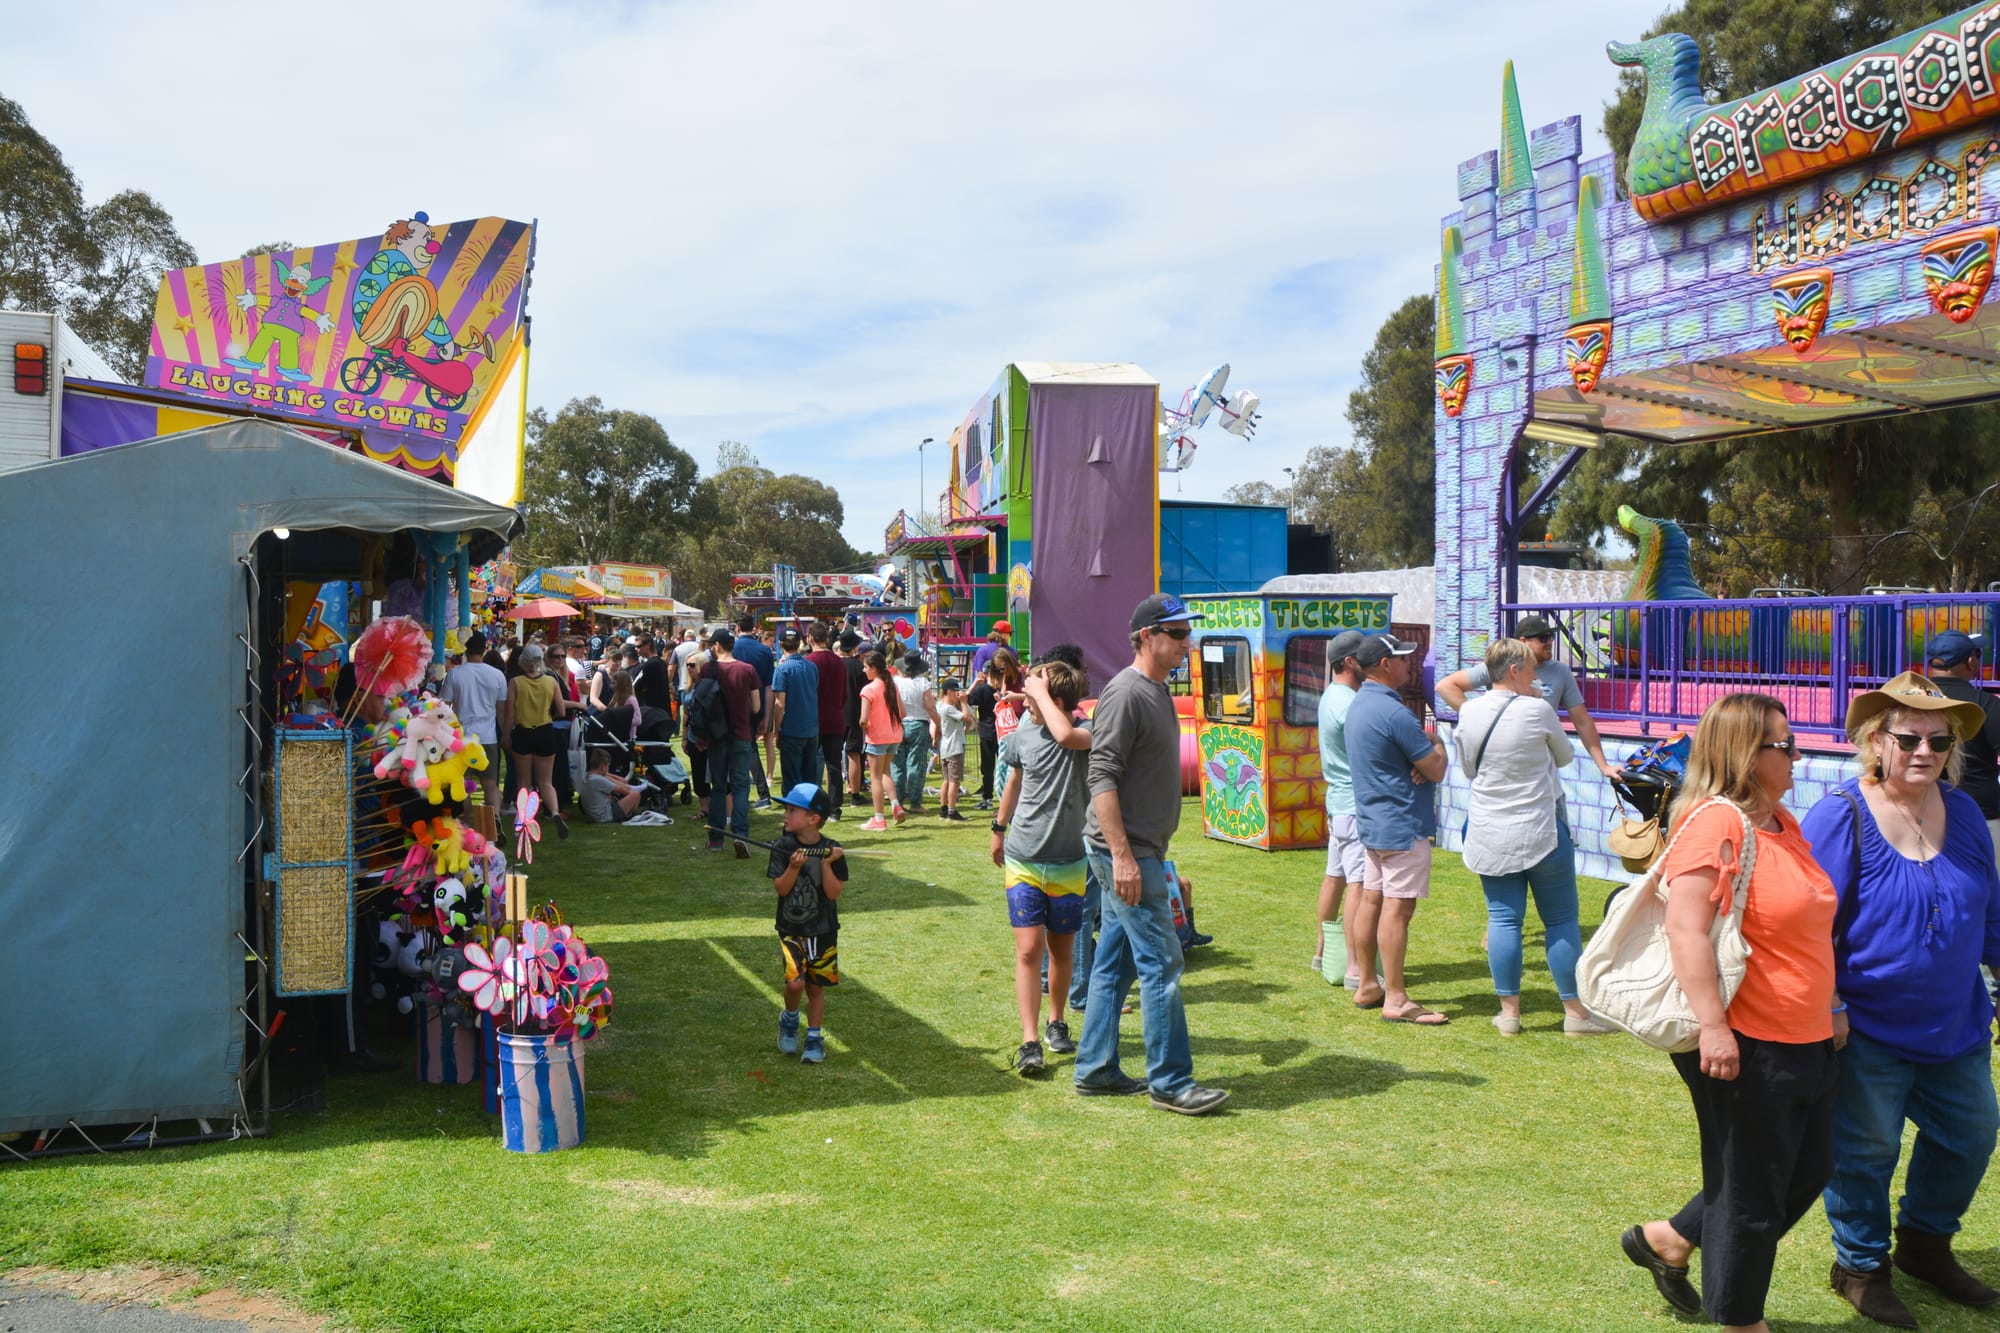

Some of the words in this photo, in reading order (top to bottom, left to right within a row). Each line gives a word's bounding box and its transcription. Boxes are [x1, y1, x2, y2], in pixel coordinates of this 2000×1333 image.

[170, 365, 326, 409] LAUGHING
[333, 397, 448, 433] CLOWNS
[1189, 600, 1263, 629] TICKETS
[1271, 600, 1391, 629] TICKETS
[1200, 726, 1264, 768] DRAGON
[1203, 782, 1267, 839] WAGON
